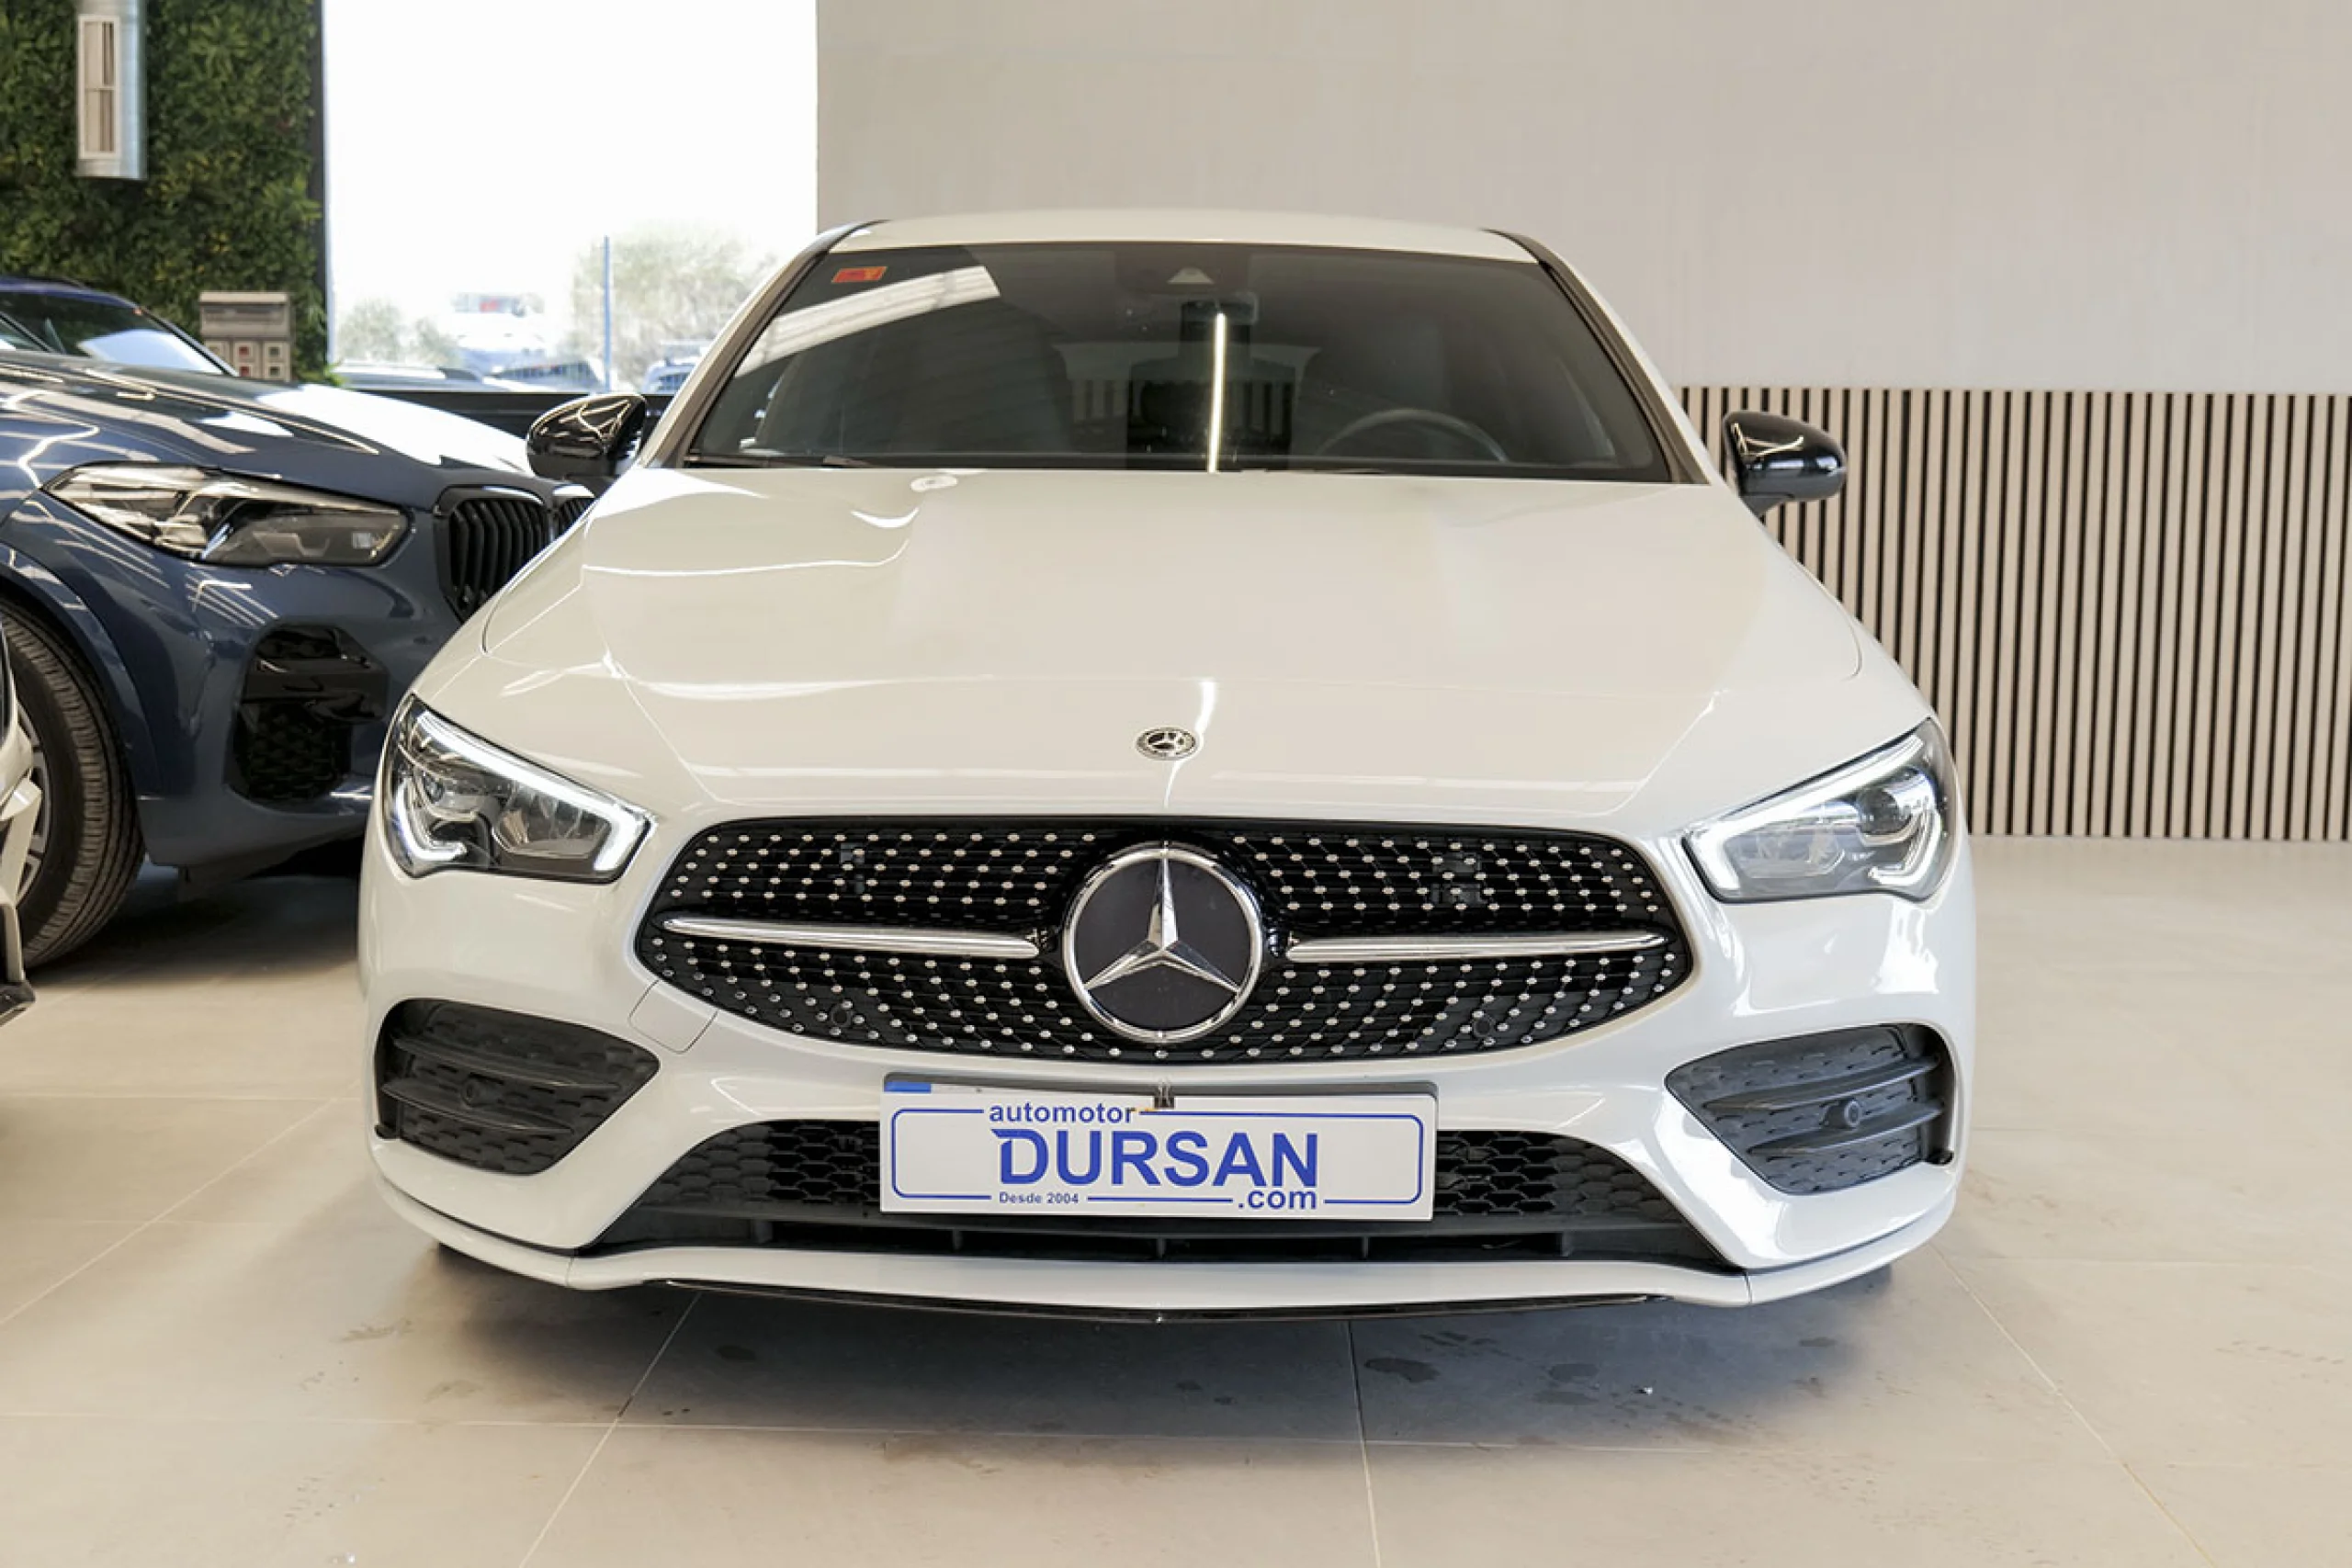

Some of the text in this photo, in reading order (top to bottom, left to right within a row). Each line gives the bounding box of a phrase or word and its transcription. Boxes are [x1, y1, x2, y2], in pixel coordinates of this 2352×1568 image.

[989, 1103, 1135, 1123] automotor
[991, 1129, 1317, 1187] DURSAN
[999, 1191, 1079, 1204] Desde 2004
[1238, 1189, 1317, 1210] .com
